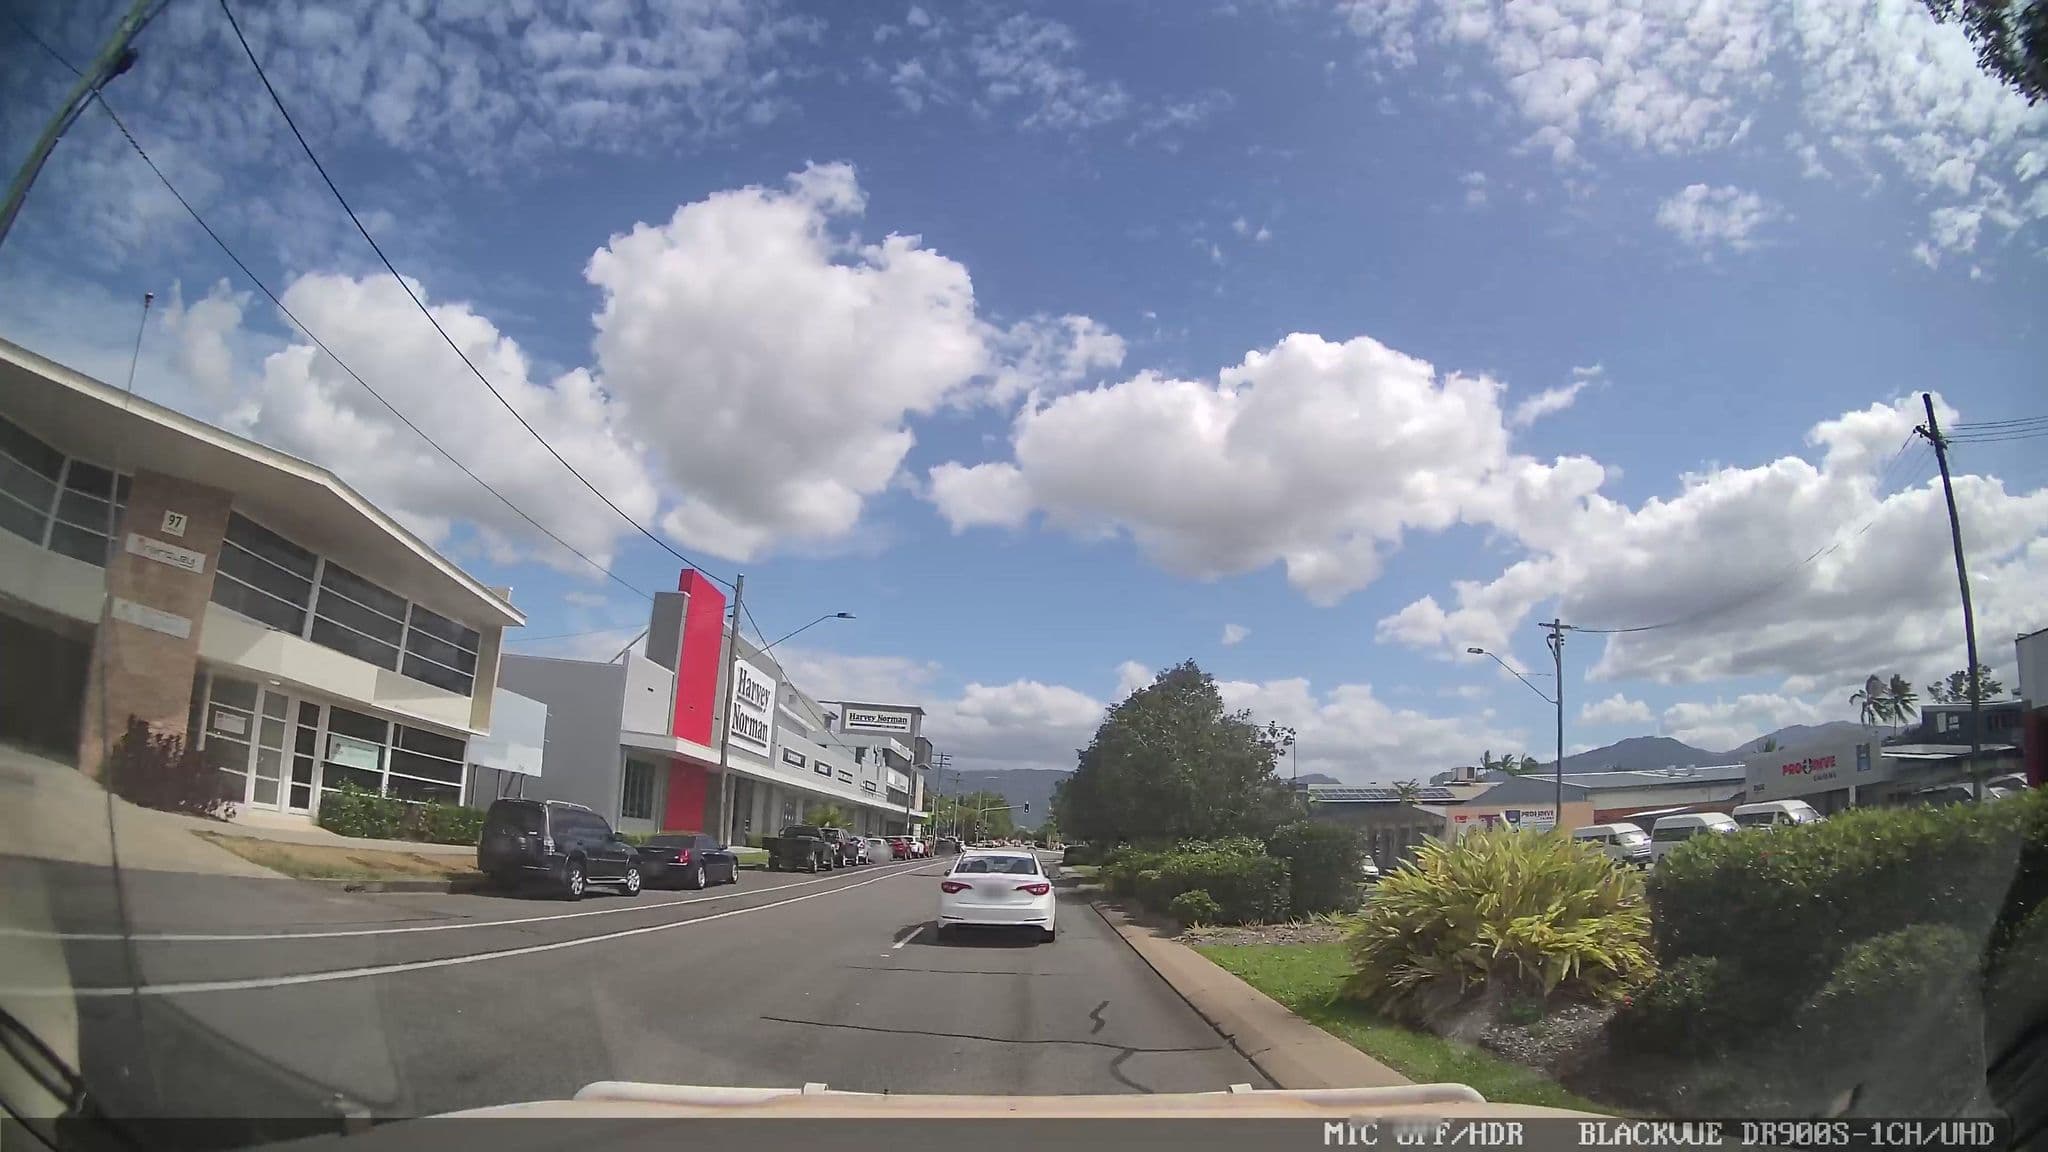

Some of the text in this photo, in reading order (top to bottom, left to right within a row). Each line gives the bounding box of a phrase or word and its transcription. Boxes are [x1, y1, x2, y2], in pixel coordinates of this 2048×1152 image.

[168, 514, 183, 527] 97
[738, 666, 771, 713] Harvey
[731, 702, 768, 742] Norman
[849, 712, 908, 724] Harvey Norman
